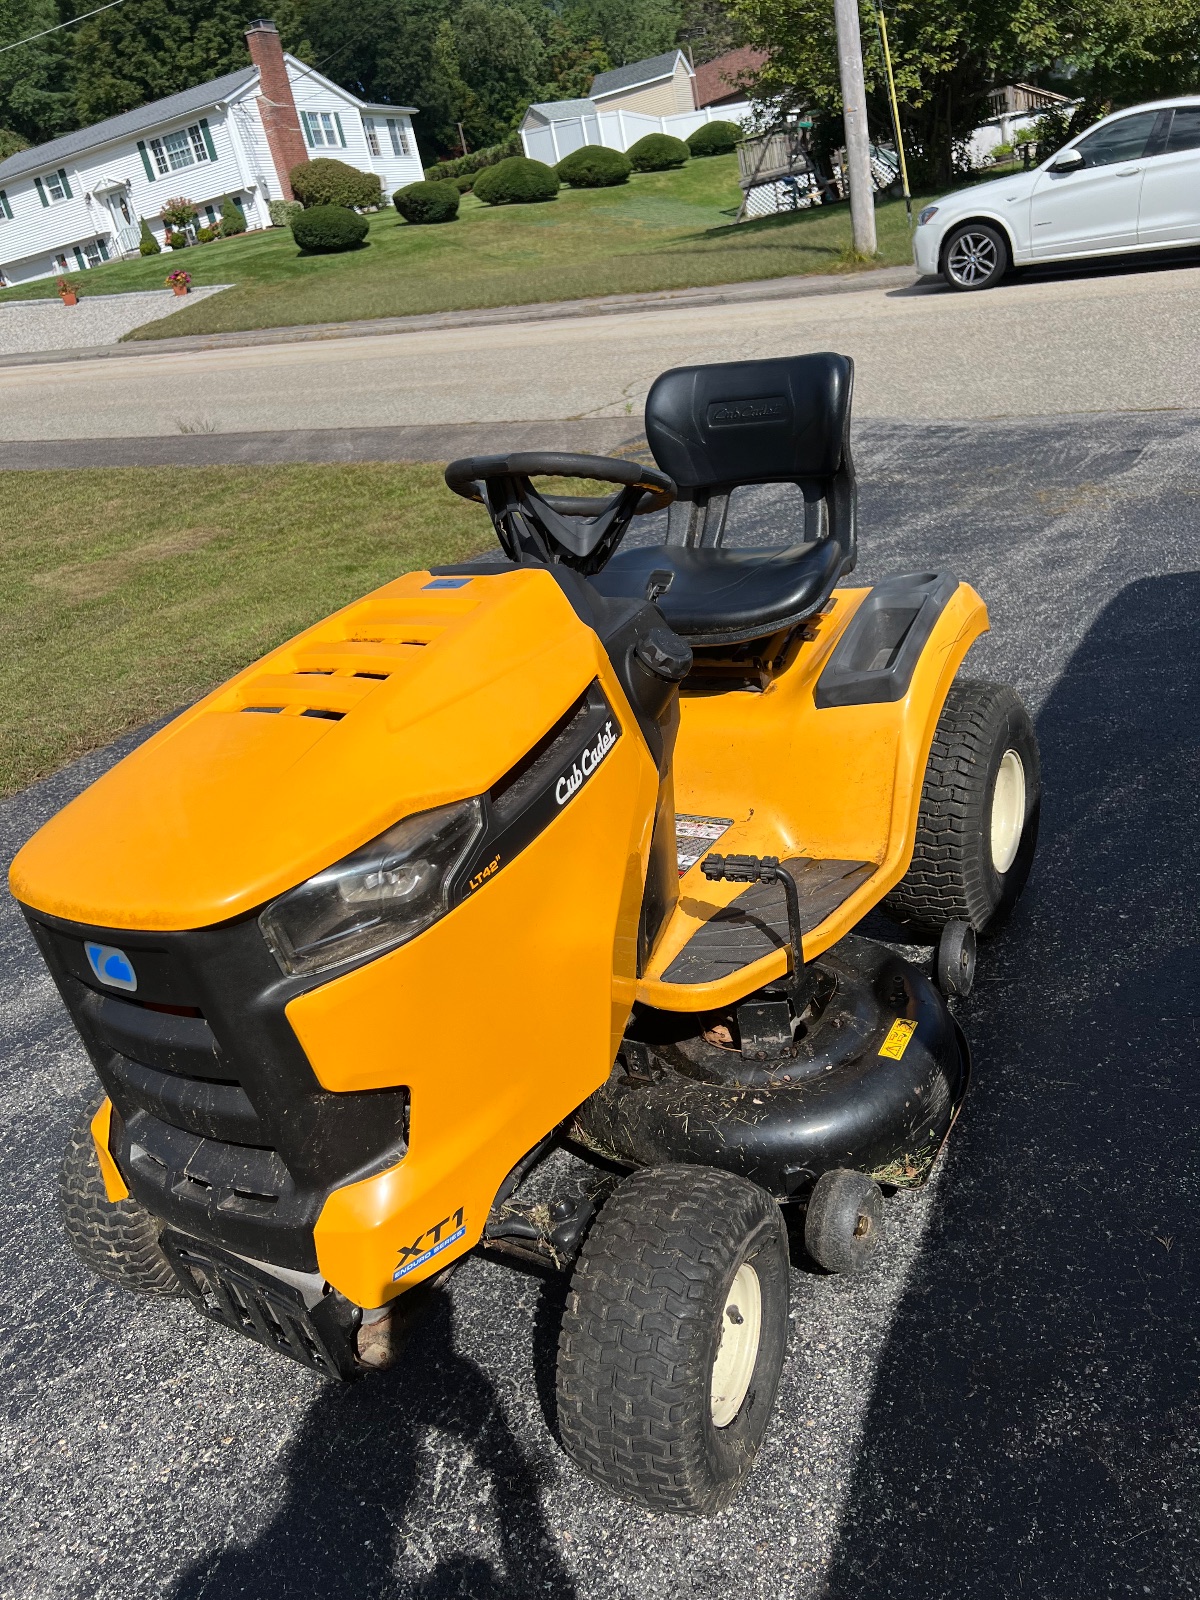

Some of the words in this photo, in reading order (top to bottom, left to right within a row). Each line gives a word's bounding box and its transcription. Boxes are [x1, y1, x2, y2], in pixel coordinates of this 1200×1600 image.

[555, 762, 583, 805] Cub
[581, 720, 617, 776] Cadet
[393, 1205, 465, 1271] XT1
[394, 1252, 432, 1279] ENDURO
[433, 1229, 463, 1254] SERIES
